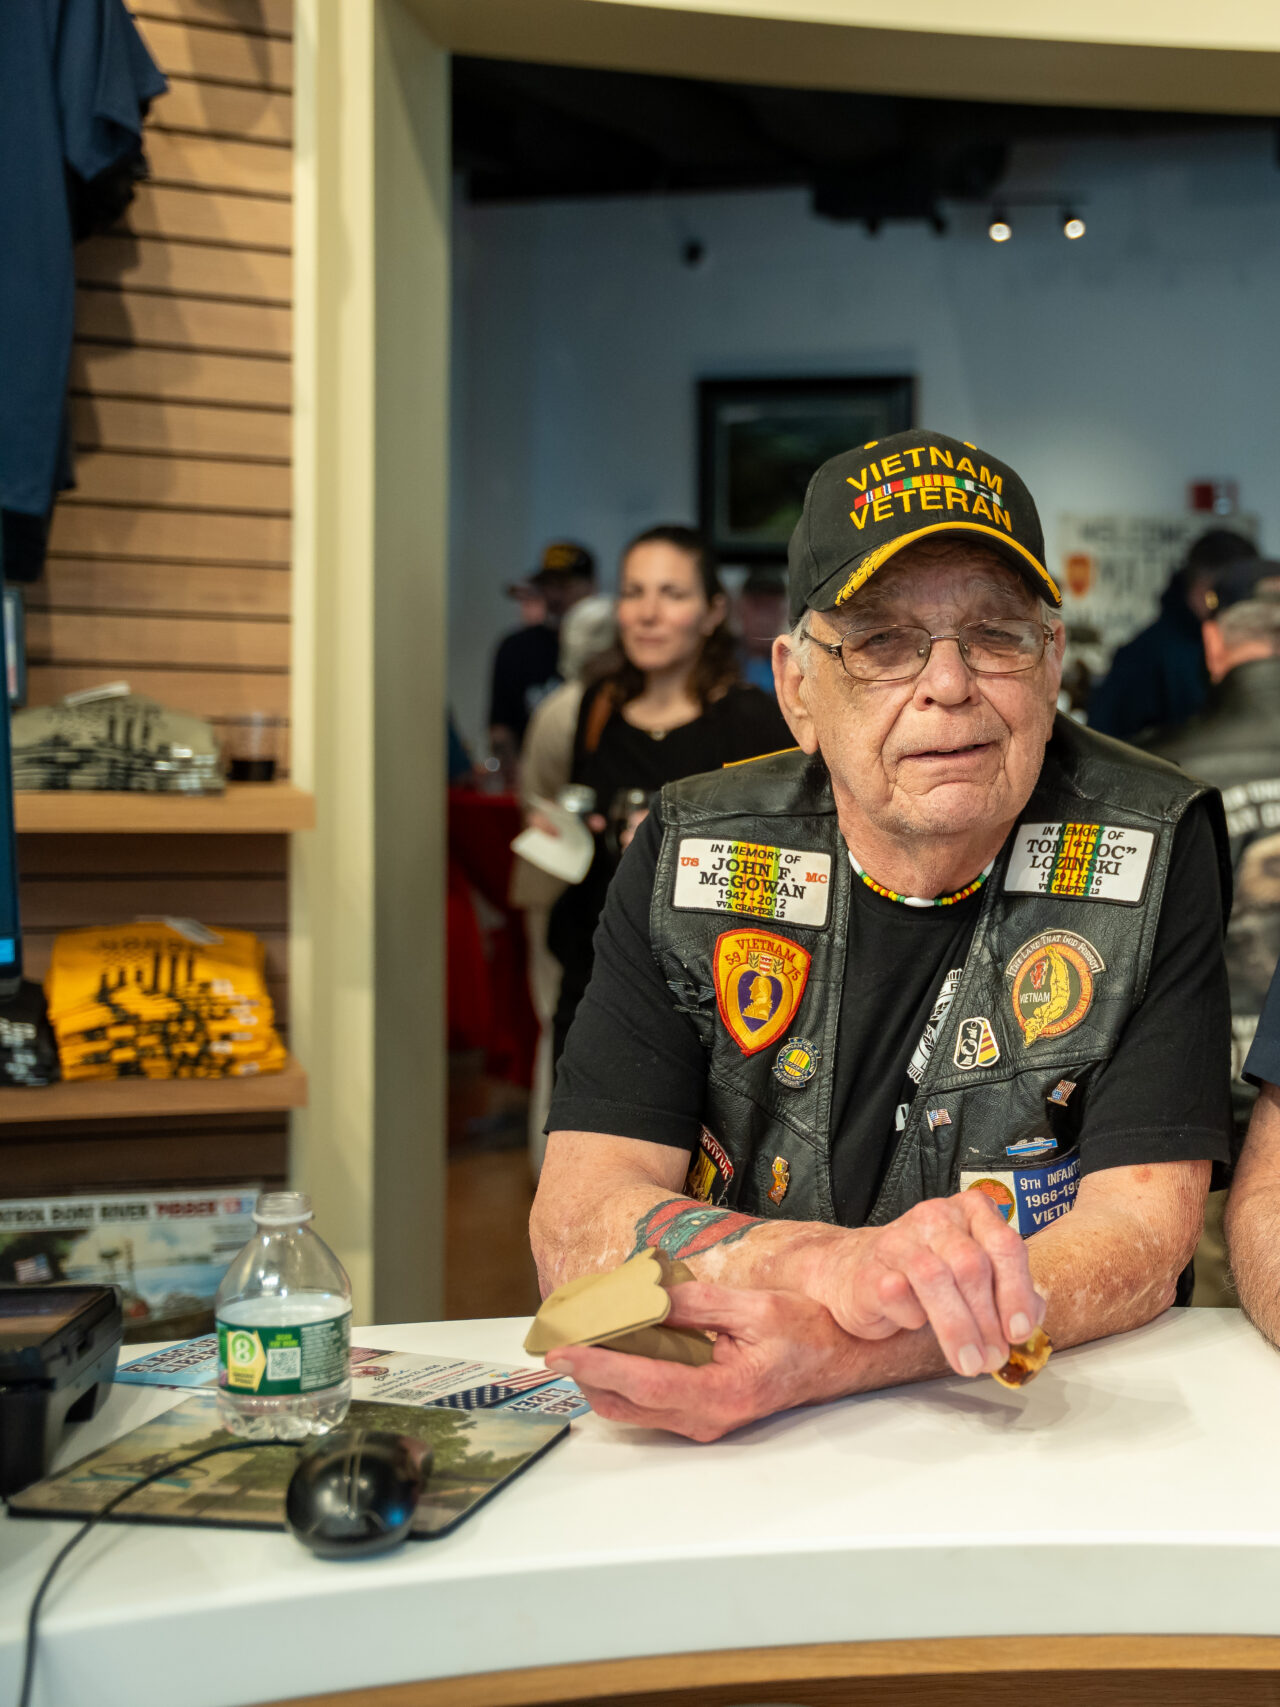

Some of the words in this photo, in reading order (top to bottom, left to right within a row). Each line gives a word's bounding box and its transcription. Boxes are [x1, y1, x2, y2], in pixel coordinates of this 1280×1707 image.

[846, 446, 1003, 495] VIETNAM
[850, 487, 1012, 533] VETERAN
[1042, 826, 1054, 836] IN
[1056, 826, 1106, 838] MEMORY
[1107, 830, 1125, 840] OF
[710, 843, 724, 854] IN
[727, 845, 781, 862] MEMORY
[785, 853, 802, 865] OF
[1026, 839, 1068, 854] TOM
[680, 857, 700, 868] US
[712, 857, 772, 878] JOHN
[778, 867, 796, 882] F.
[1029, 855, 1122, 876] LOZINSKI
[699, 871, 807, 899] McGOWAN
[805, 872, 828, 884] MC
[718, 889, 748, 902] 1947
[757, 894, 787, 910] 2012
[1091, 887, 1100, 895] 12
[735, 903, 774, 917] CHAPTER
[736, 938, 796, 963] VIETNAM
[1040, 935, 1062, 945] THAT
[724, 952, 741, 966] 59
[786, 965, 802, 981] 75
[1020, 992, 1051, 1004] VIETNAM
[1020, 1178, 1041, 1191] 9TH
[1025, 1178, 1080, 1209] 1966-196
[1032, 1200, 1075, 1225] VIETN
